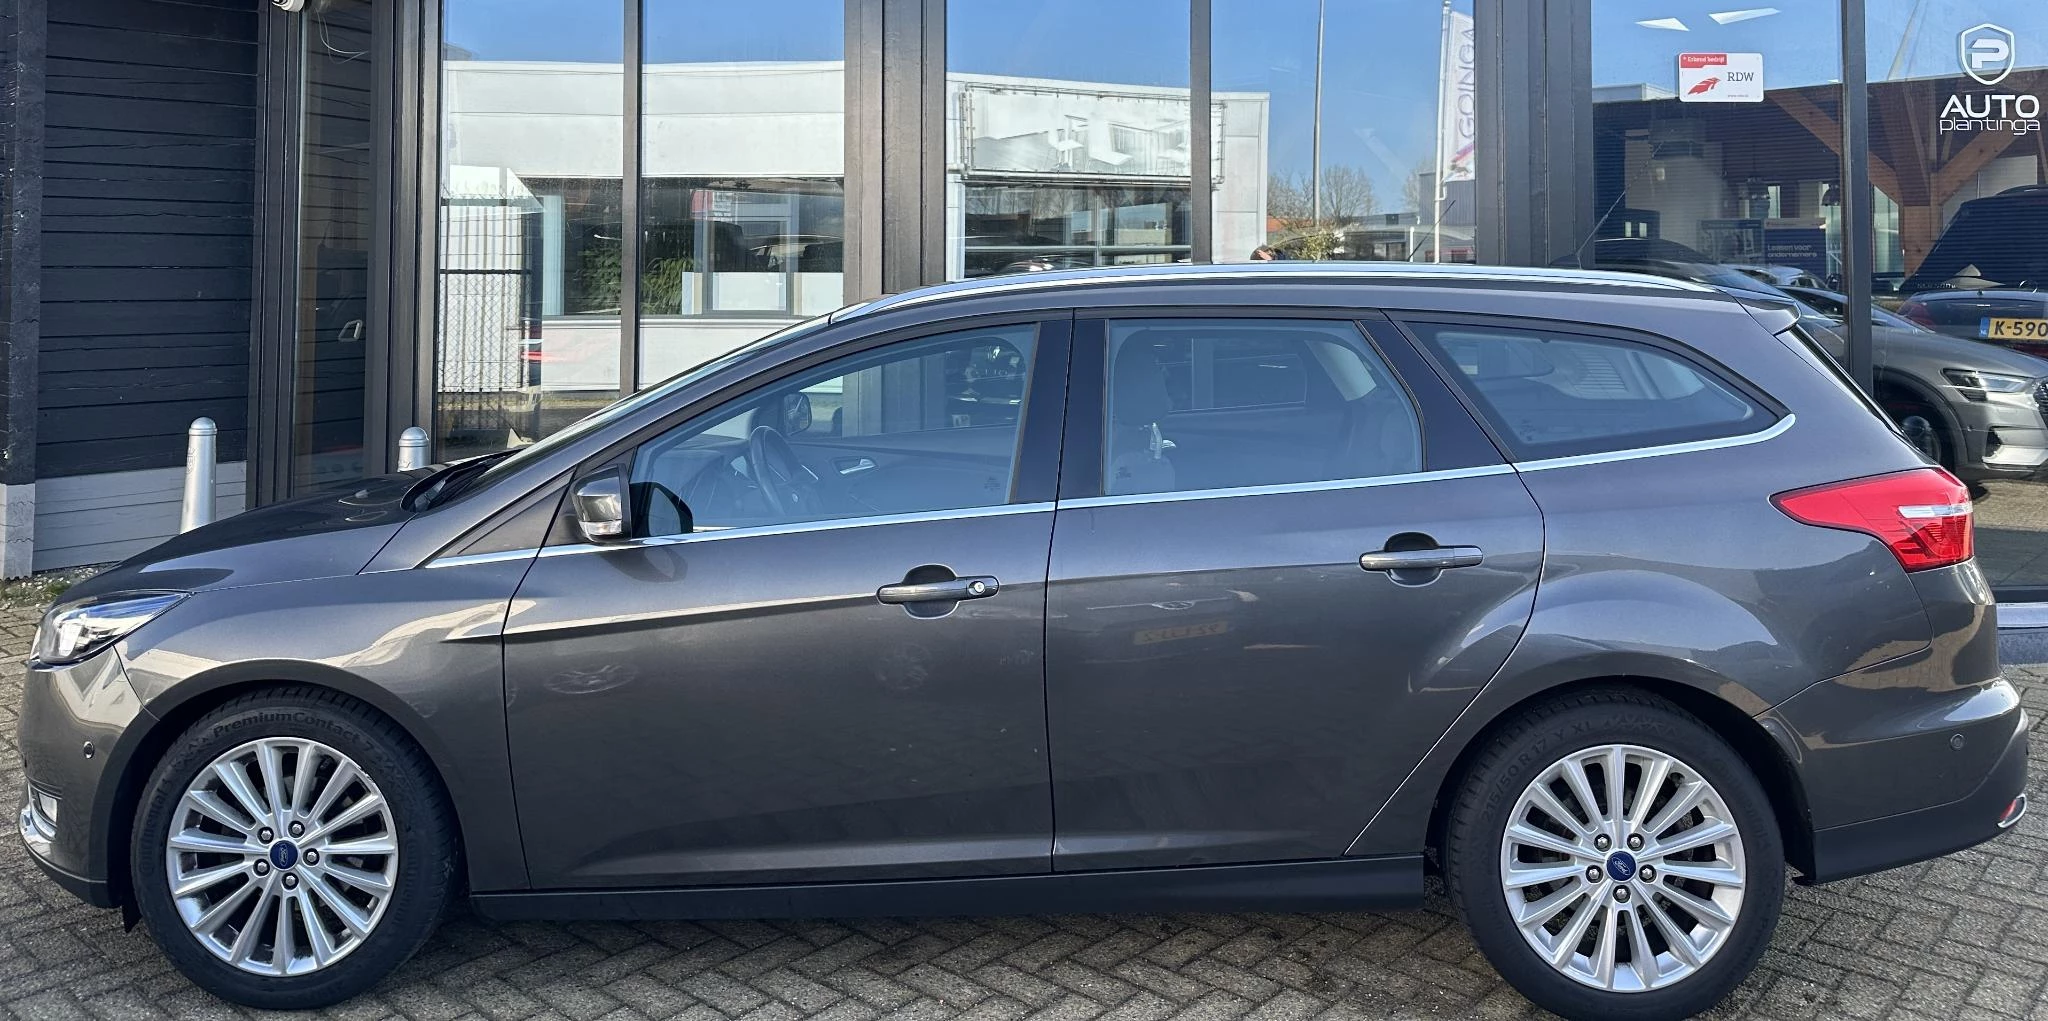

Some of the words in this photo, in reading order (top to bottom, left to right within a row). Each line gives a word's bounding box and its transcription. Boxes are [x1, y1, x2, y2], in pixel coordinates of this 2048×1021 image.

[1727, 71, 1754, 82] RDW
[1940, 94, 2040, 118] AUTO
[1940, 117, 2040, 135] plantinga
[212, 711, 361, 740] PremiumContact
[1481, 763, 1521, 821] 215/50
[1516, 751, 1533, 768] R
[1529, 738, 1550, 757] 17
[1569, 719, 1592, 737] XL
